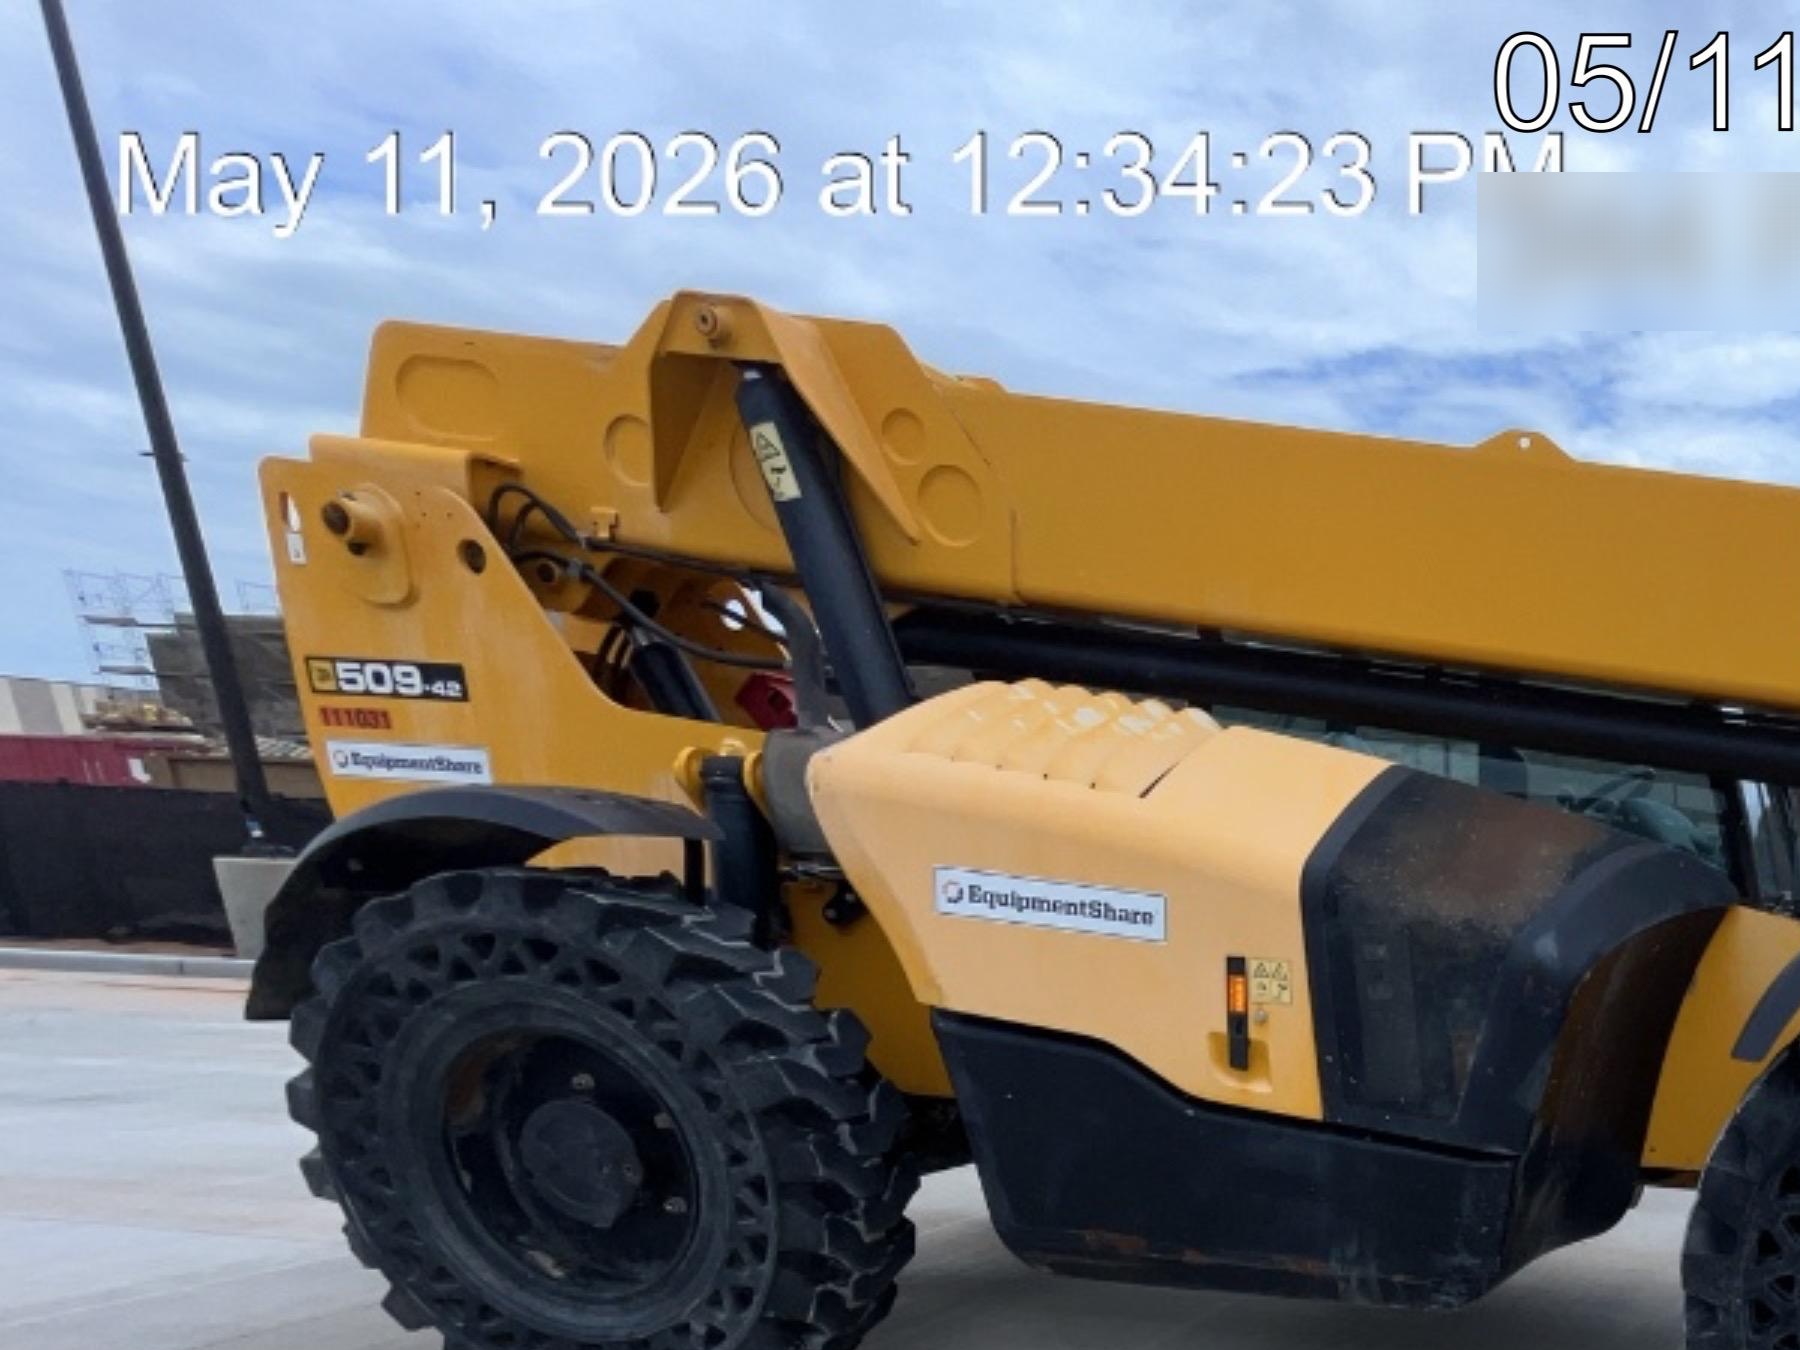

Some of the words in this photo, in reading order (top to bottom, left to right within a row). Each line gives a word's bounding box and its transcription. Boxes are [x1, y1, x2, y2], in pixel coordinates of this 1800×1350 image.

[335, 660, 464, 698] 509-42
[350, 751, 483, 776] EquipmentShare
[967, 884, 1155, 926] EquipmentShare
